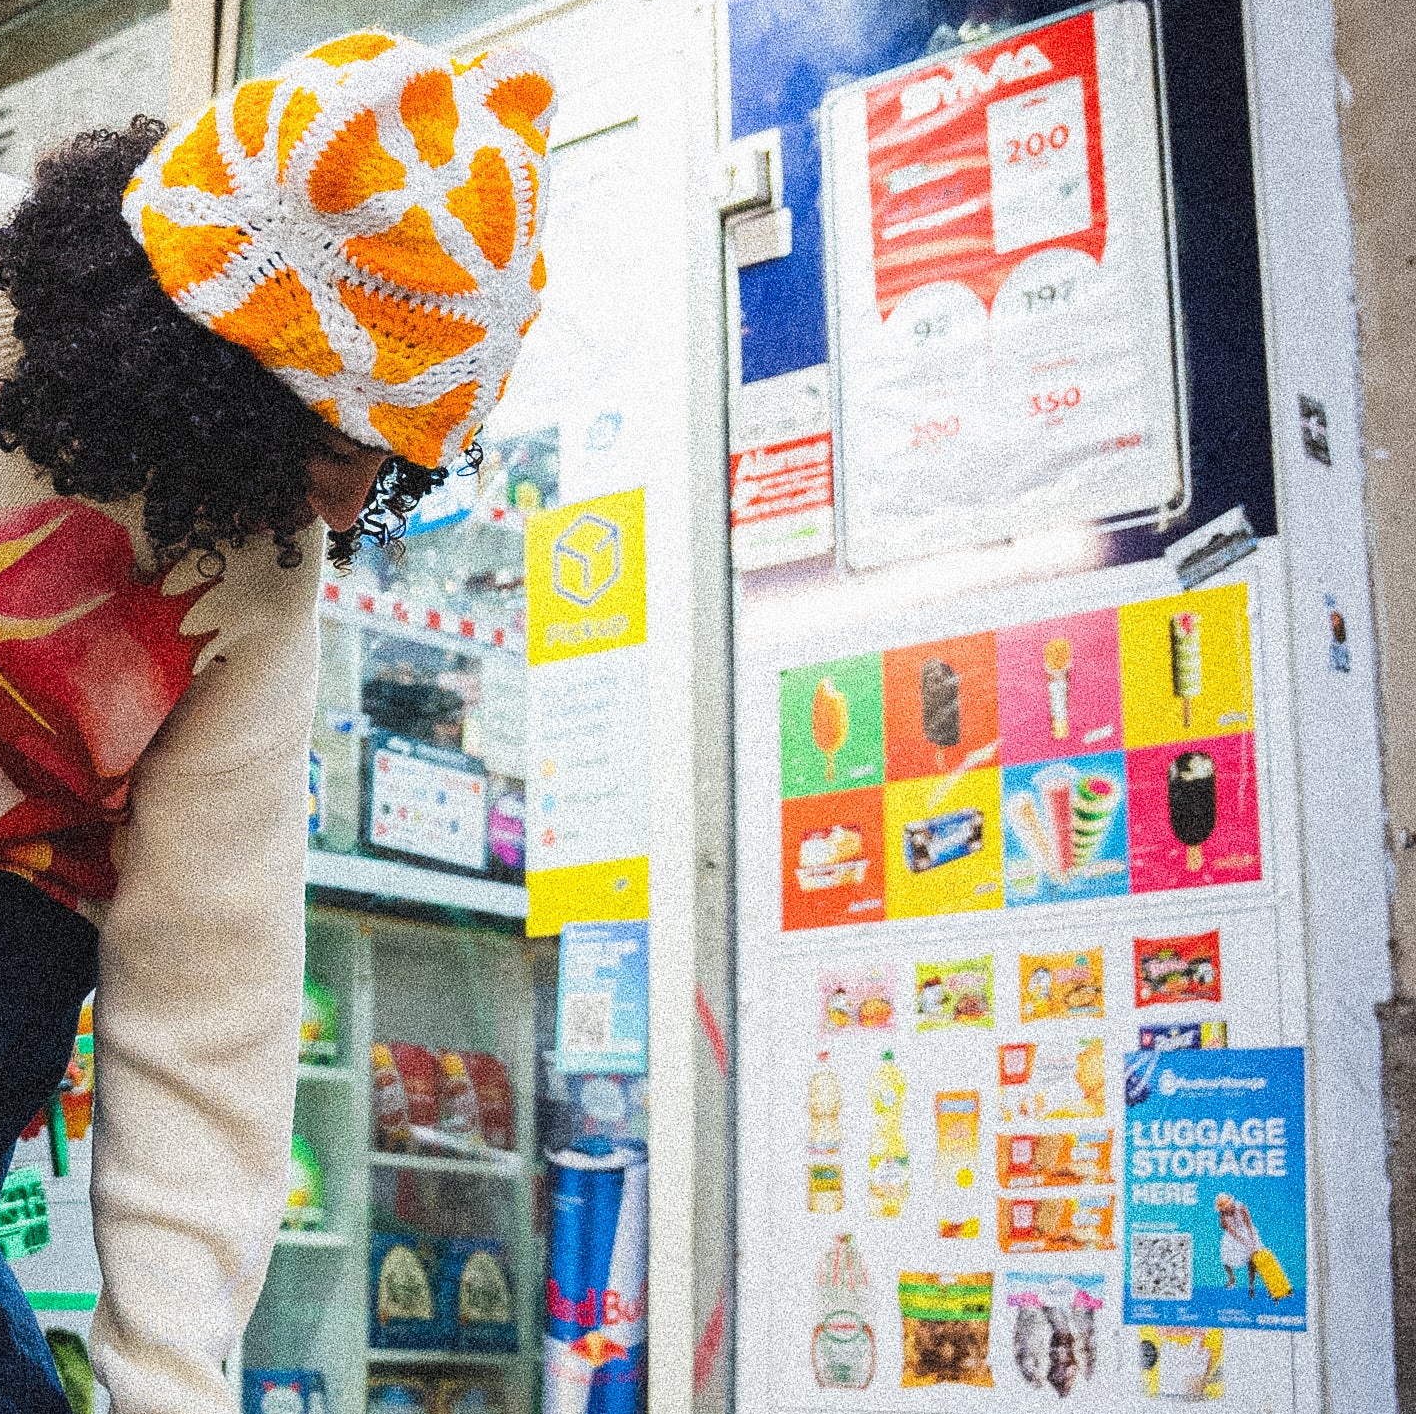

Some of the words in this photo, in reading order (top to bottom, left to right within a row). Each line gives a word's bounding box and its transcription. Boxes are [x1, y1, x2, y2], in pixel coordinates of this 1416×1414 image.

[1004, 124, 1071, 165] 200
[1132, 1117, 1287, 1147] LUGGAGE
[1131, 1147, 1288, 1178] STORAGE
[1131, 1182, 1198, 1206] HERE
